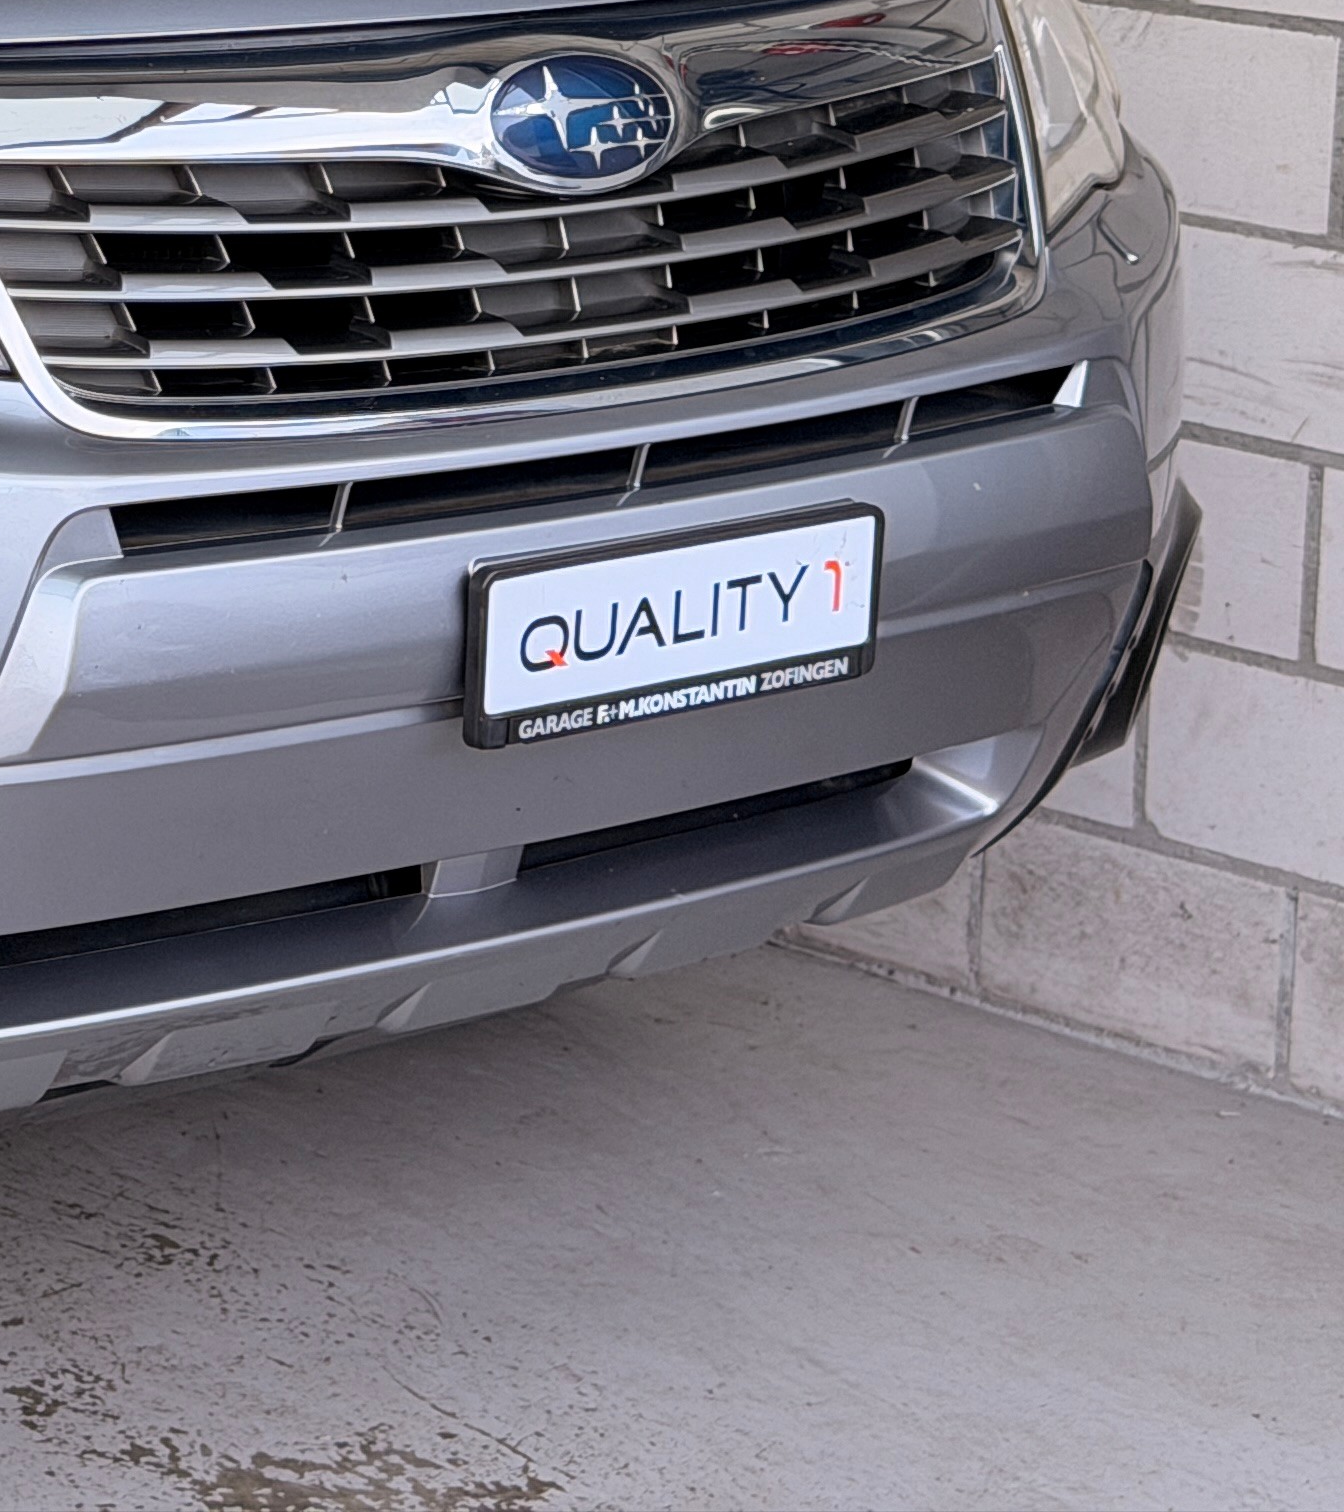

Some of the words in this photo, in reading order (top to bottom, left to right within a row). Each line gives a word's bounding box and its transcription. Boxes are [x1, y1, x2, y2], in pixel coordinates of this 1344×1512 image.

[519, 564, 810, 673] QUALITY
[823, 559, 843, 613] 1
[518, 707, 594, 739] GARAGE
[760, 656, 849, 692] ZOFINGEN
